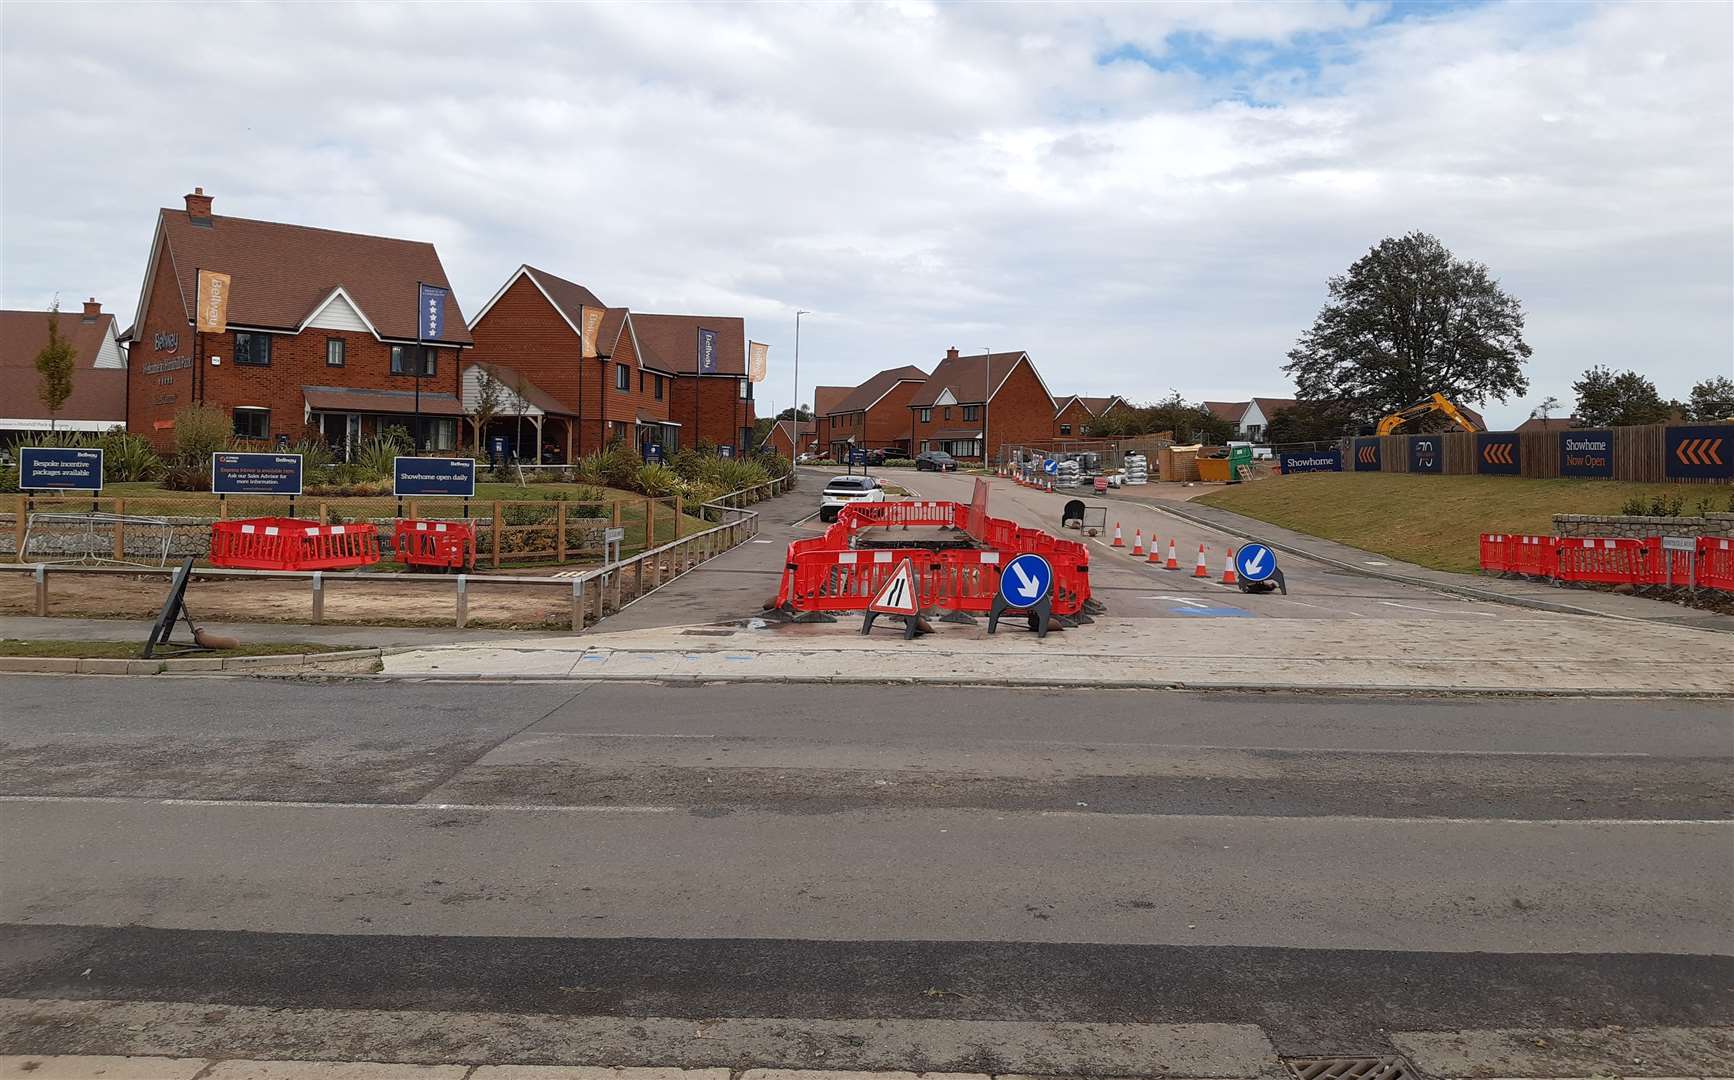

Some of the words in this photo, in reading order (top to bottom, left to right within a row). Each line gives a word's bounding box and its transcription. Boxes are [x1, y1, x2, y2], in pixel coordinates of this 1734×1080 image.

[207, 279, 222, 327] Bellway
[704, 334, 713, 369] Bellway
[1566, 438, 1606, 451] Showhome
[33, 460, 60, 468] Bespoke
[61, 460, 90, 468] incentive
[1287, 457, 1334, 467] Showhome
[1567, 455, 1584, 466] Now
[1585, 454, 1605, 469] Open
[32, 469, 61, 477] packages
